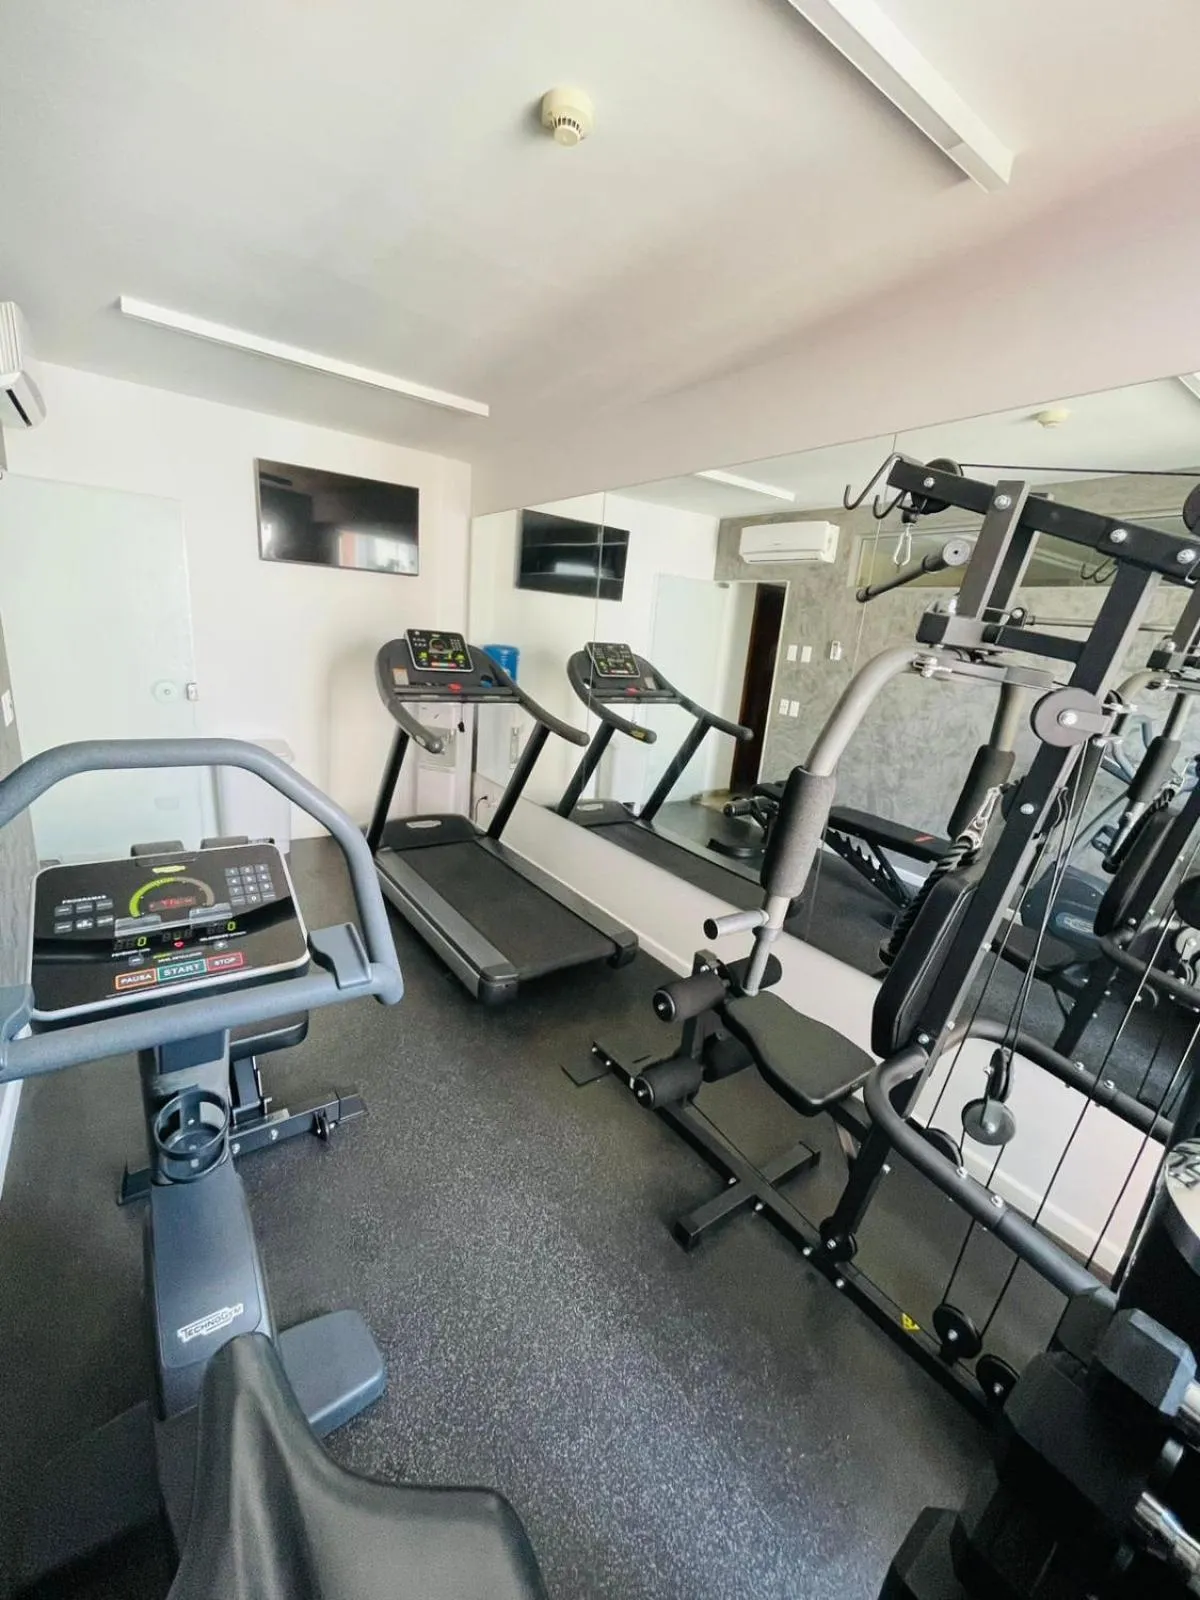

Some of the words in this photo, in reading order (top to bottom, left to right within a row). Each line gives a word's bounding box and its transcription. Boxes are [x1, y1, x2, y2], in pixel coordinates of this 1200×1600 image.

[137, 936, 147, 947] 0
[214, 957, 237, 967] STOP
[163, 963, 201, 977] START
[120, 974, 152, 985] PAUSA
